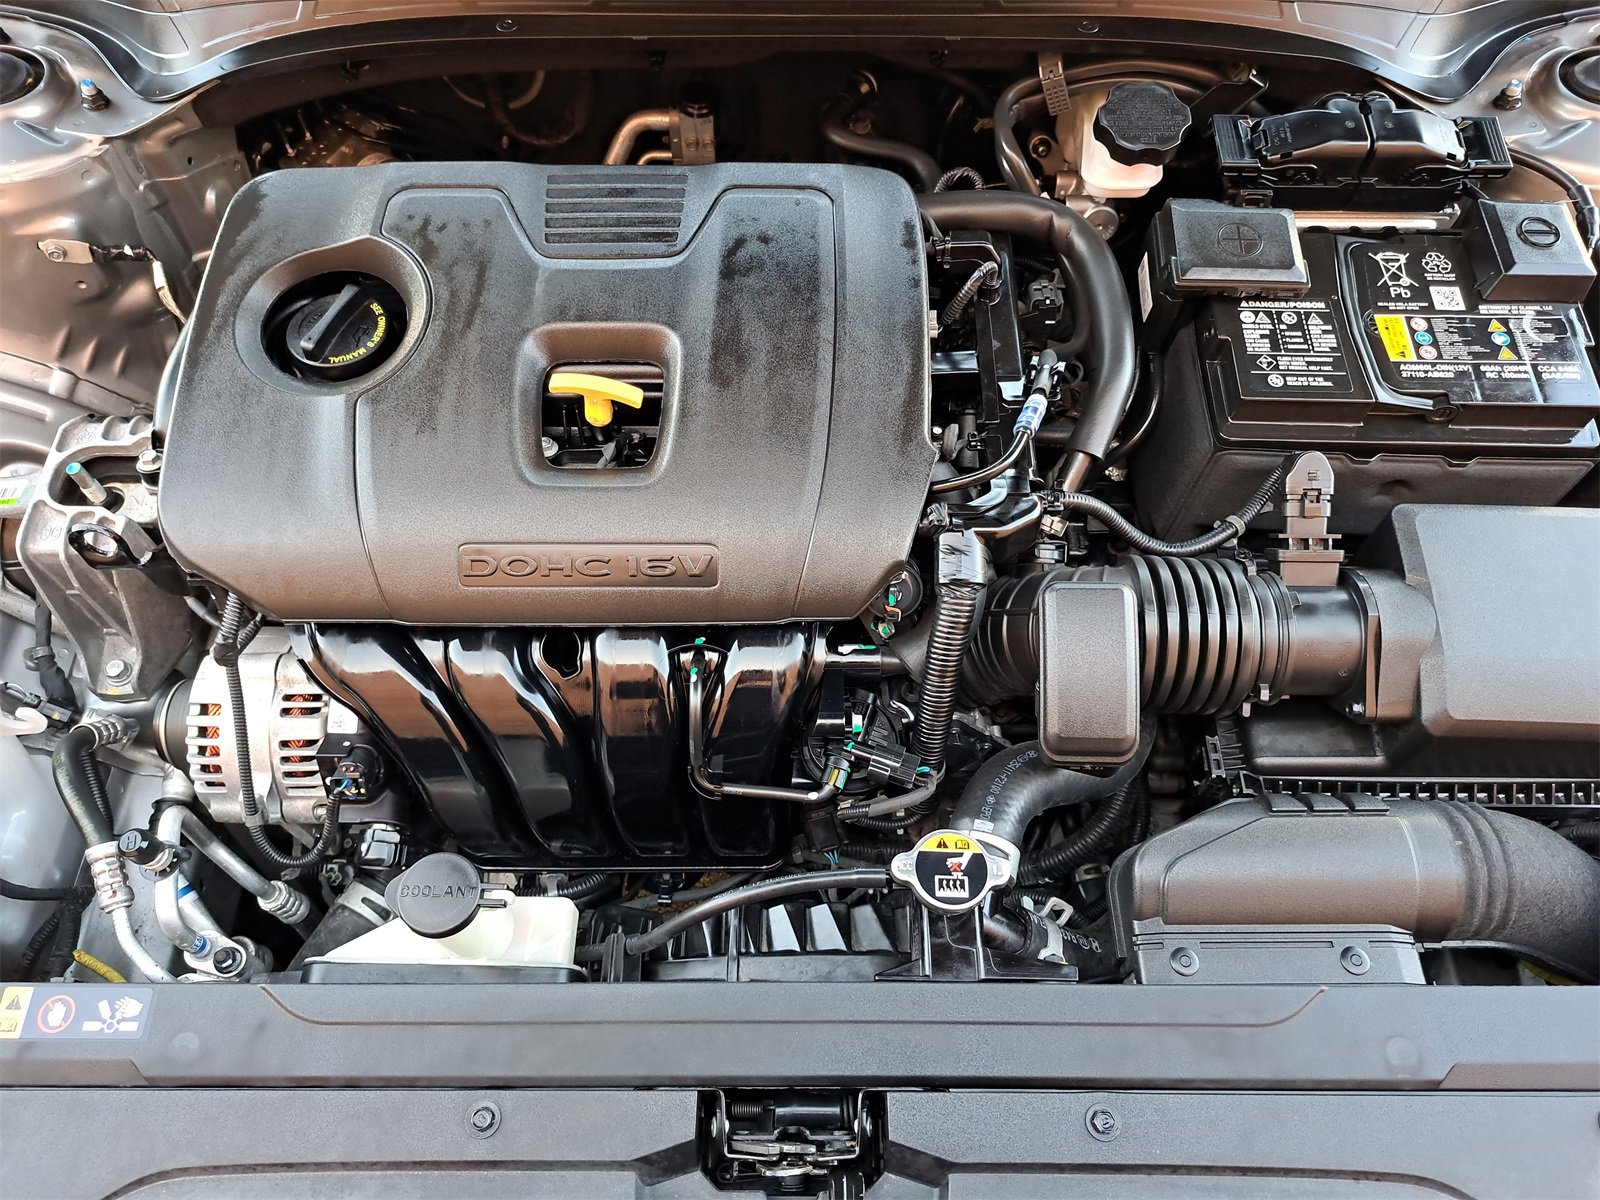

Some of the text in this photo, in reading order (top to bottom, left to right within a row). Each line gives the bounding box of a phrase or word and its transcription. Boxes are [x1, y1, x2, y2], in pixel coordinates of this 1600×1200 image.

[1389, 287, 1411, 298] Pb
[1248, 301, 1326, 309] DANGER/POISON
[328, 303, 386, 364] SEE OWNER'S MANUAL
[462, 554, 714, 578] DOHC 16V
[400, 884, 479, 899] COOLANT
